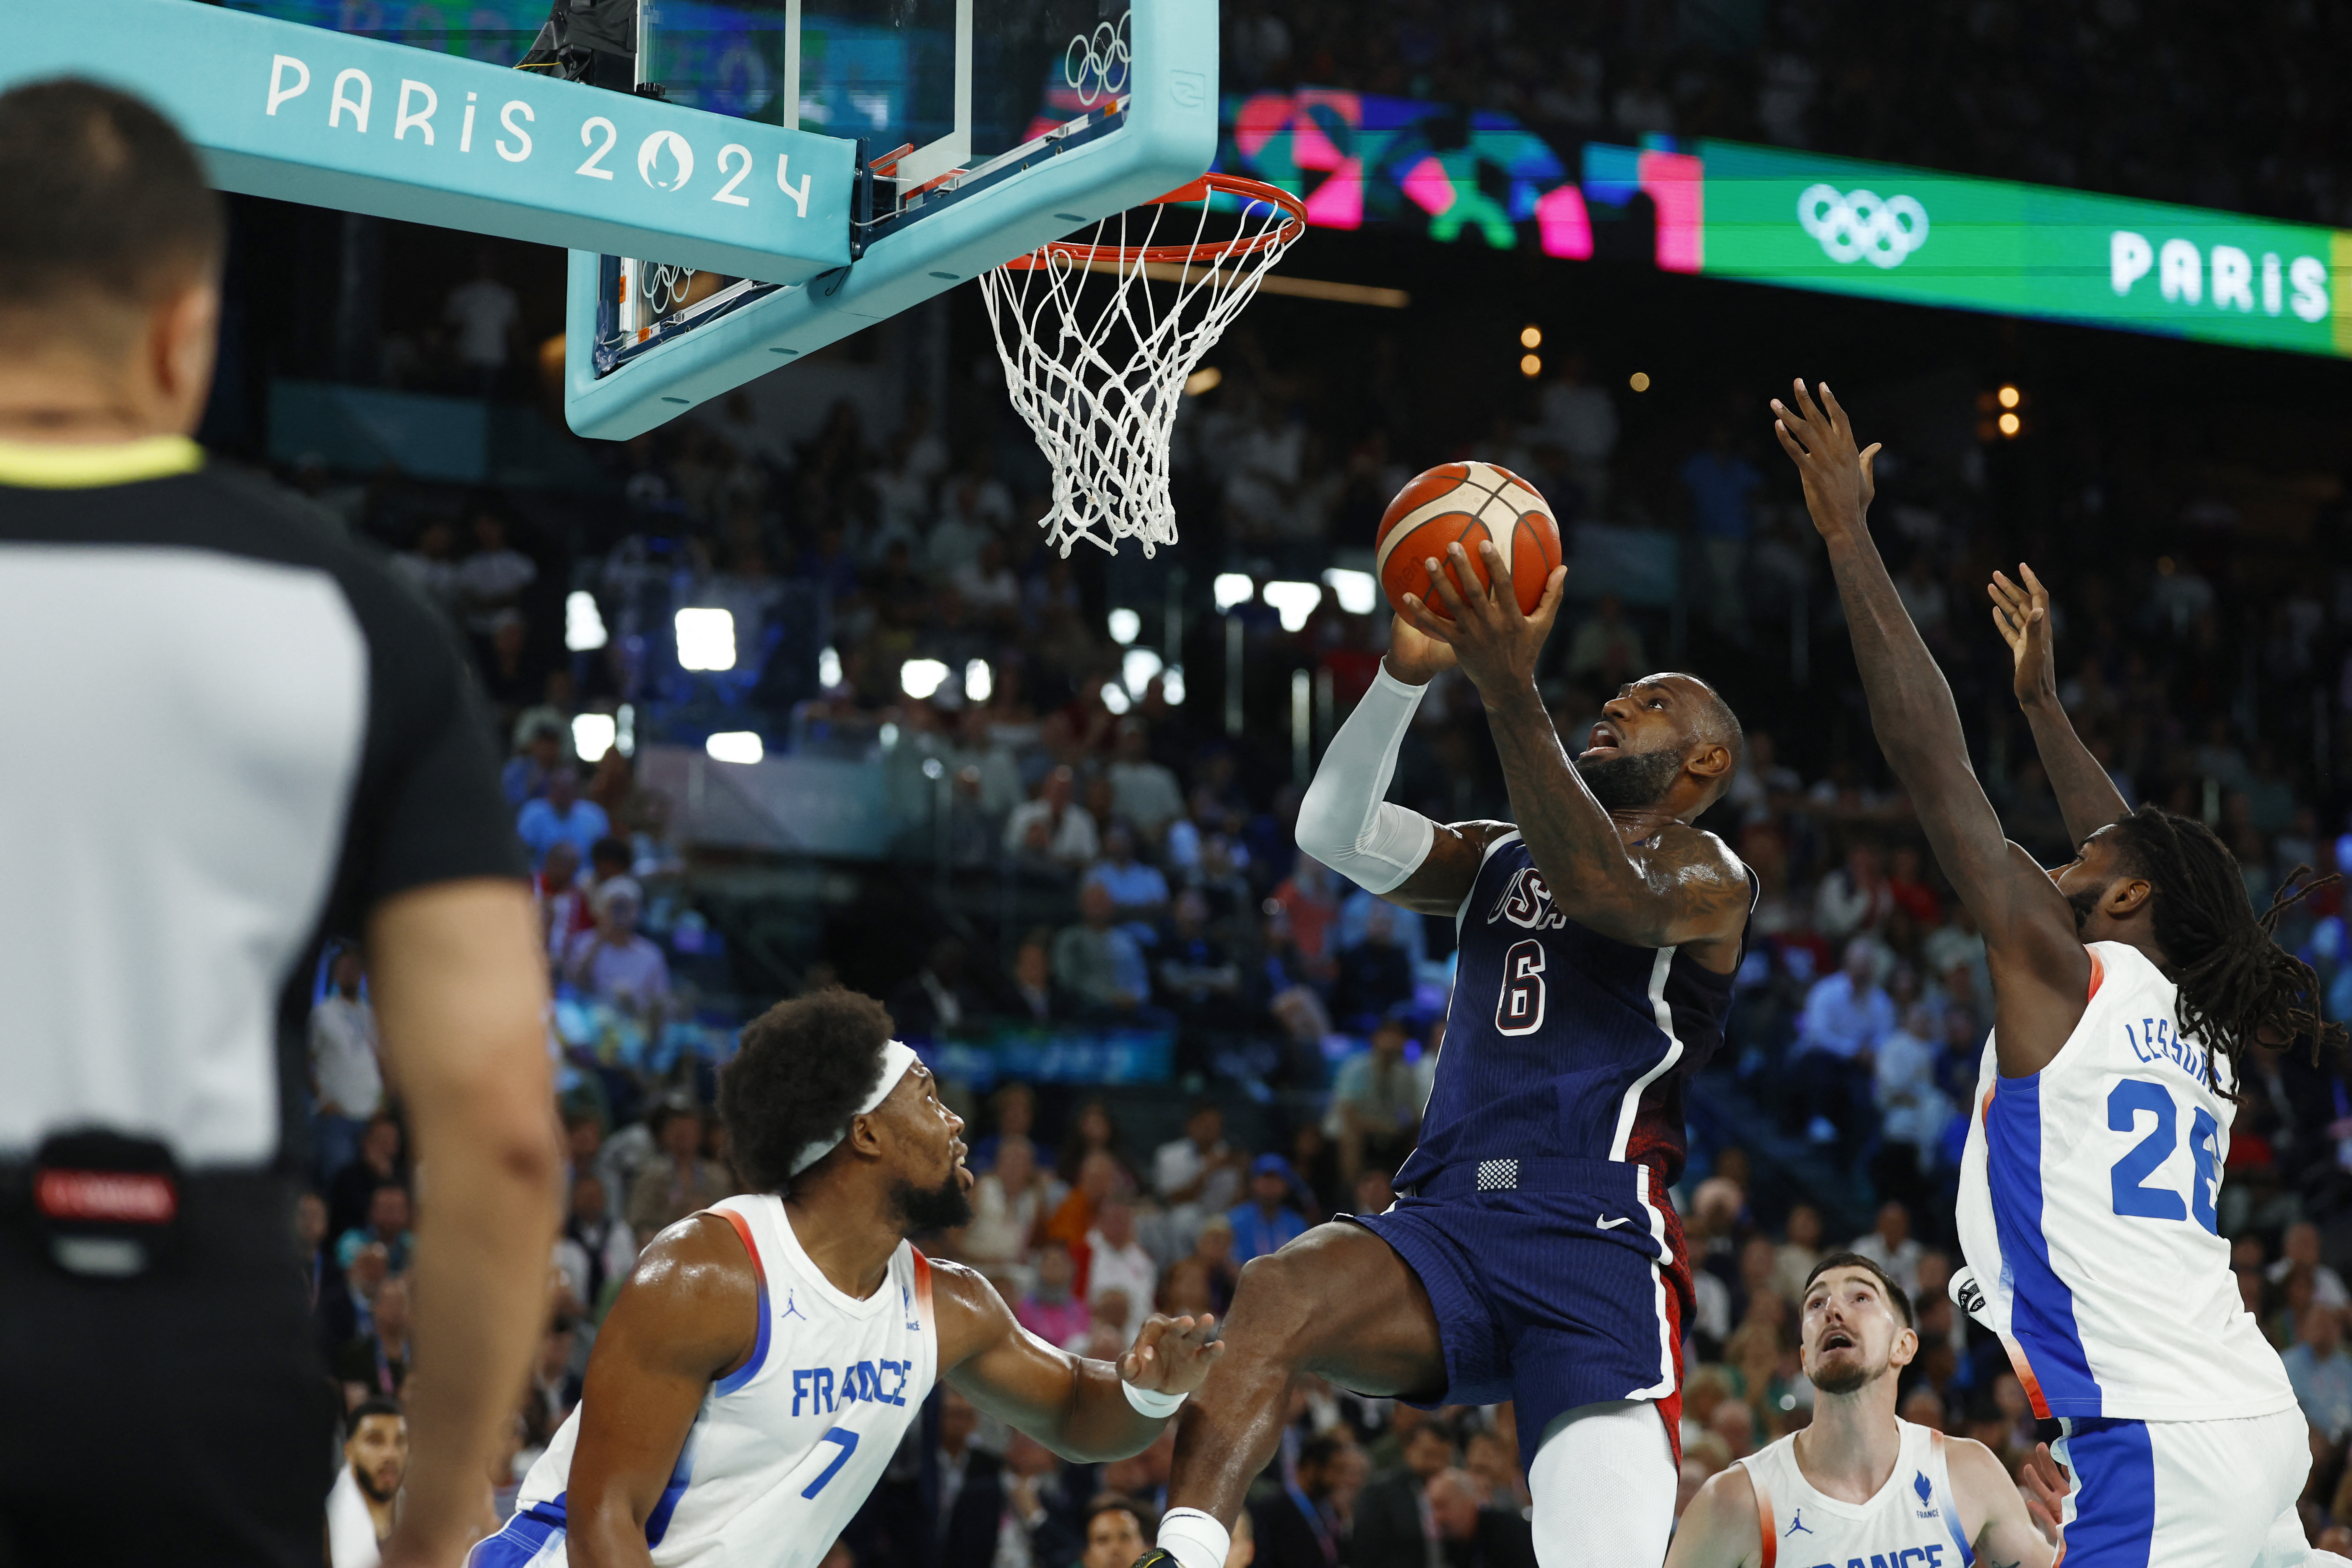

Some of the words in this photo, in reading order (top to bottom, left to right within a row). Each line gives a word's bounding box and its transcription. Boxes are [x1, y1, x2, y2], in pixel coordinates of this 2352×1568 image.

[1495, 938, 1546, 1037] 6
[792, 1358, 912, 1417] FRANCE
[801, 1427, 860, 1500] 7
[1916, 1508, 1940, 1519] FRANCE
